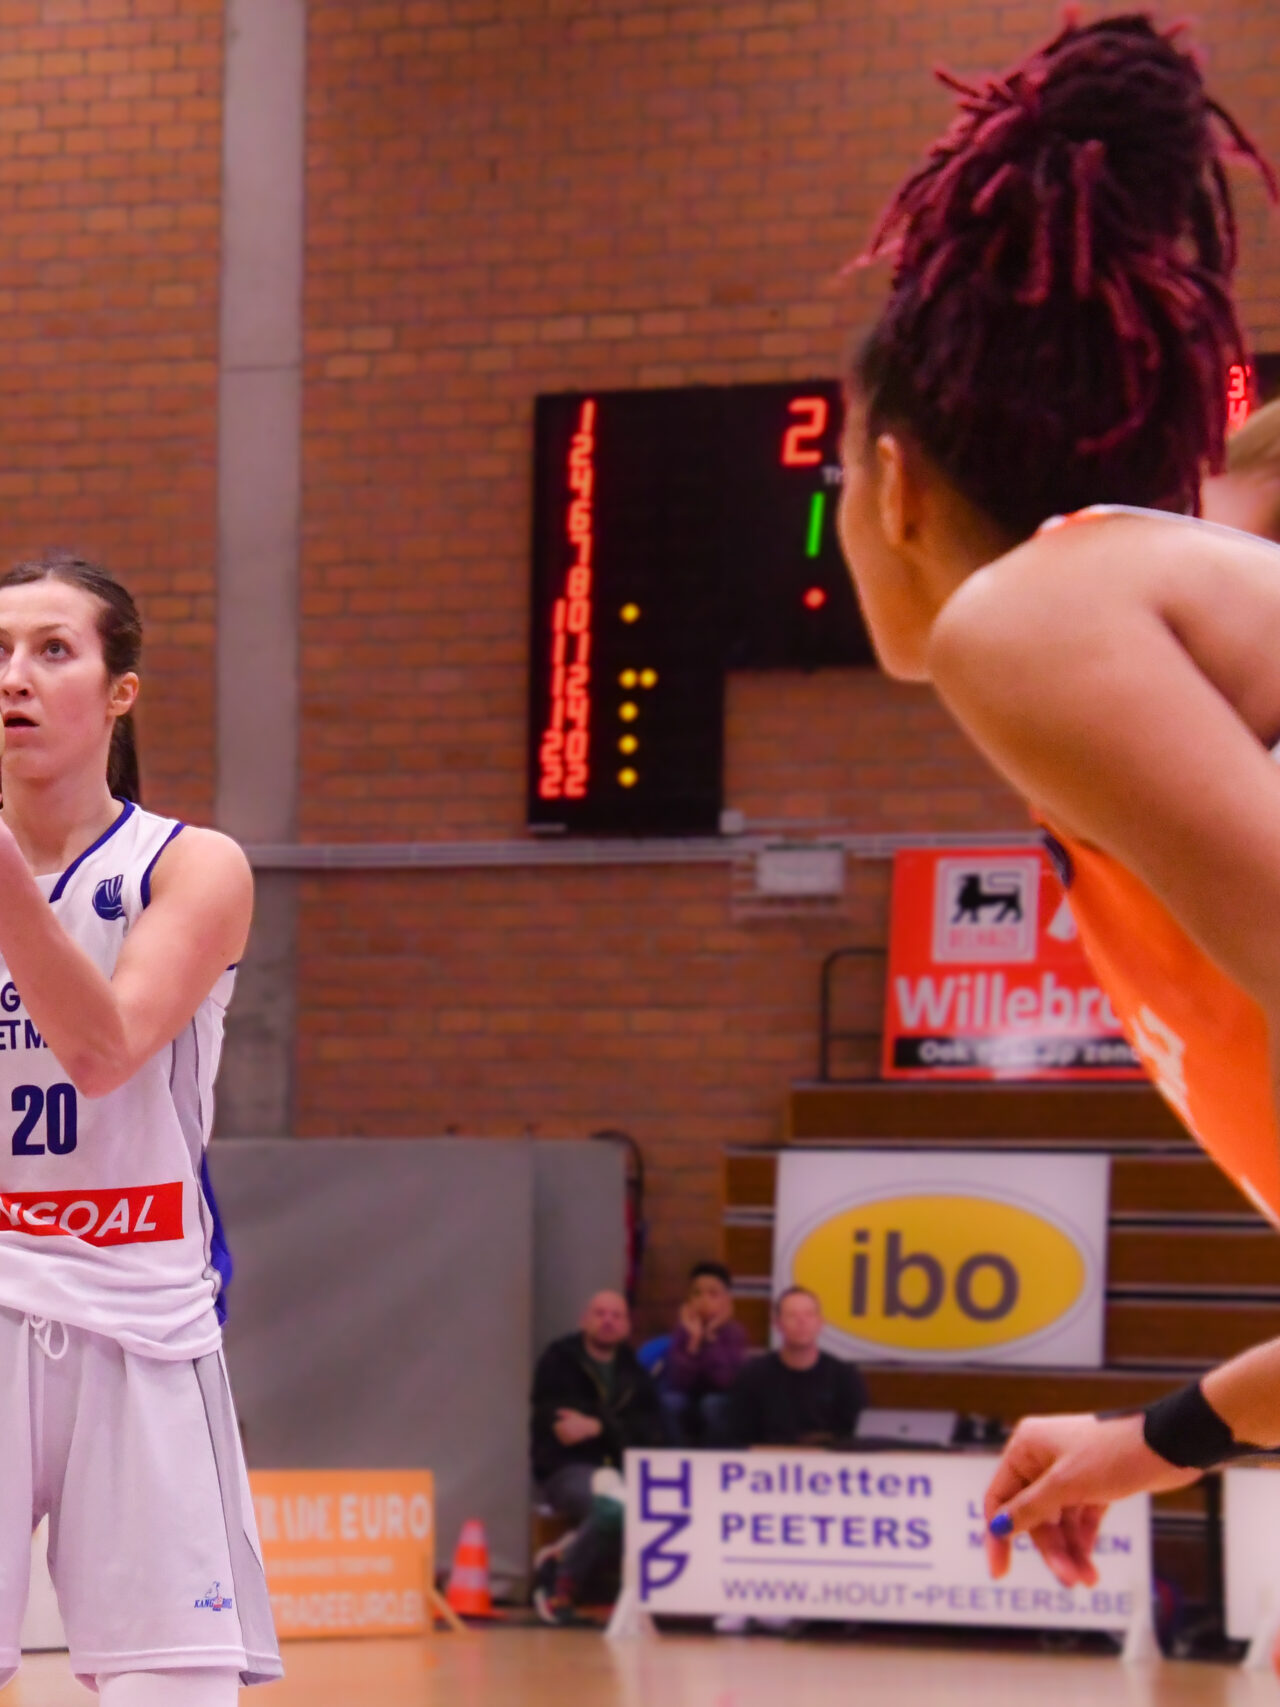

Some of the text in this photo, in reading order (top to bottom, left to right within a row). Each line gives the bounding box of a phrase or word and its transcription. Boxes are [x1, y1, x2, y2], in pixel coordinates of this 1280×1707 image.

[580, 398, 596, 435] 1
[781, 396, 828, 467] 2
[568, 433, 594, 468] 2
[568, 466, 594, 499] 4
[567, 498, 592, 535] 6
[568, 533, 592, 567] 7
[566, 565, 592, 600] 8
[552, 597, 592, 633] 10
[552, 630, 591, 667] 11
[551, 664, 590, 699] 12
[551, 696, 590, 732] 14
[540, 729, 589, 766] 20
[539, 762, 588, 798] 22
[11, 1083, 77, 1155] 20
[850, 1228, 1019, 1322] ibo
[720, 1462, 933, 1498] Palletten
[339, 1494, 431, 1540] EURO
[721, 1513, 933, 1551] PEETERS
[723, 1578, 1134, 1616] WWW.HOUT-PEETERS.BE
